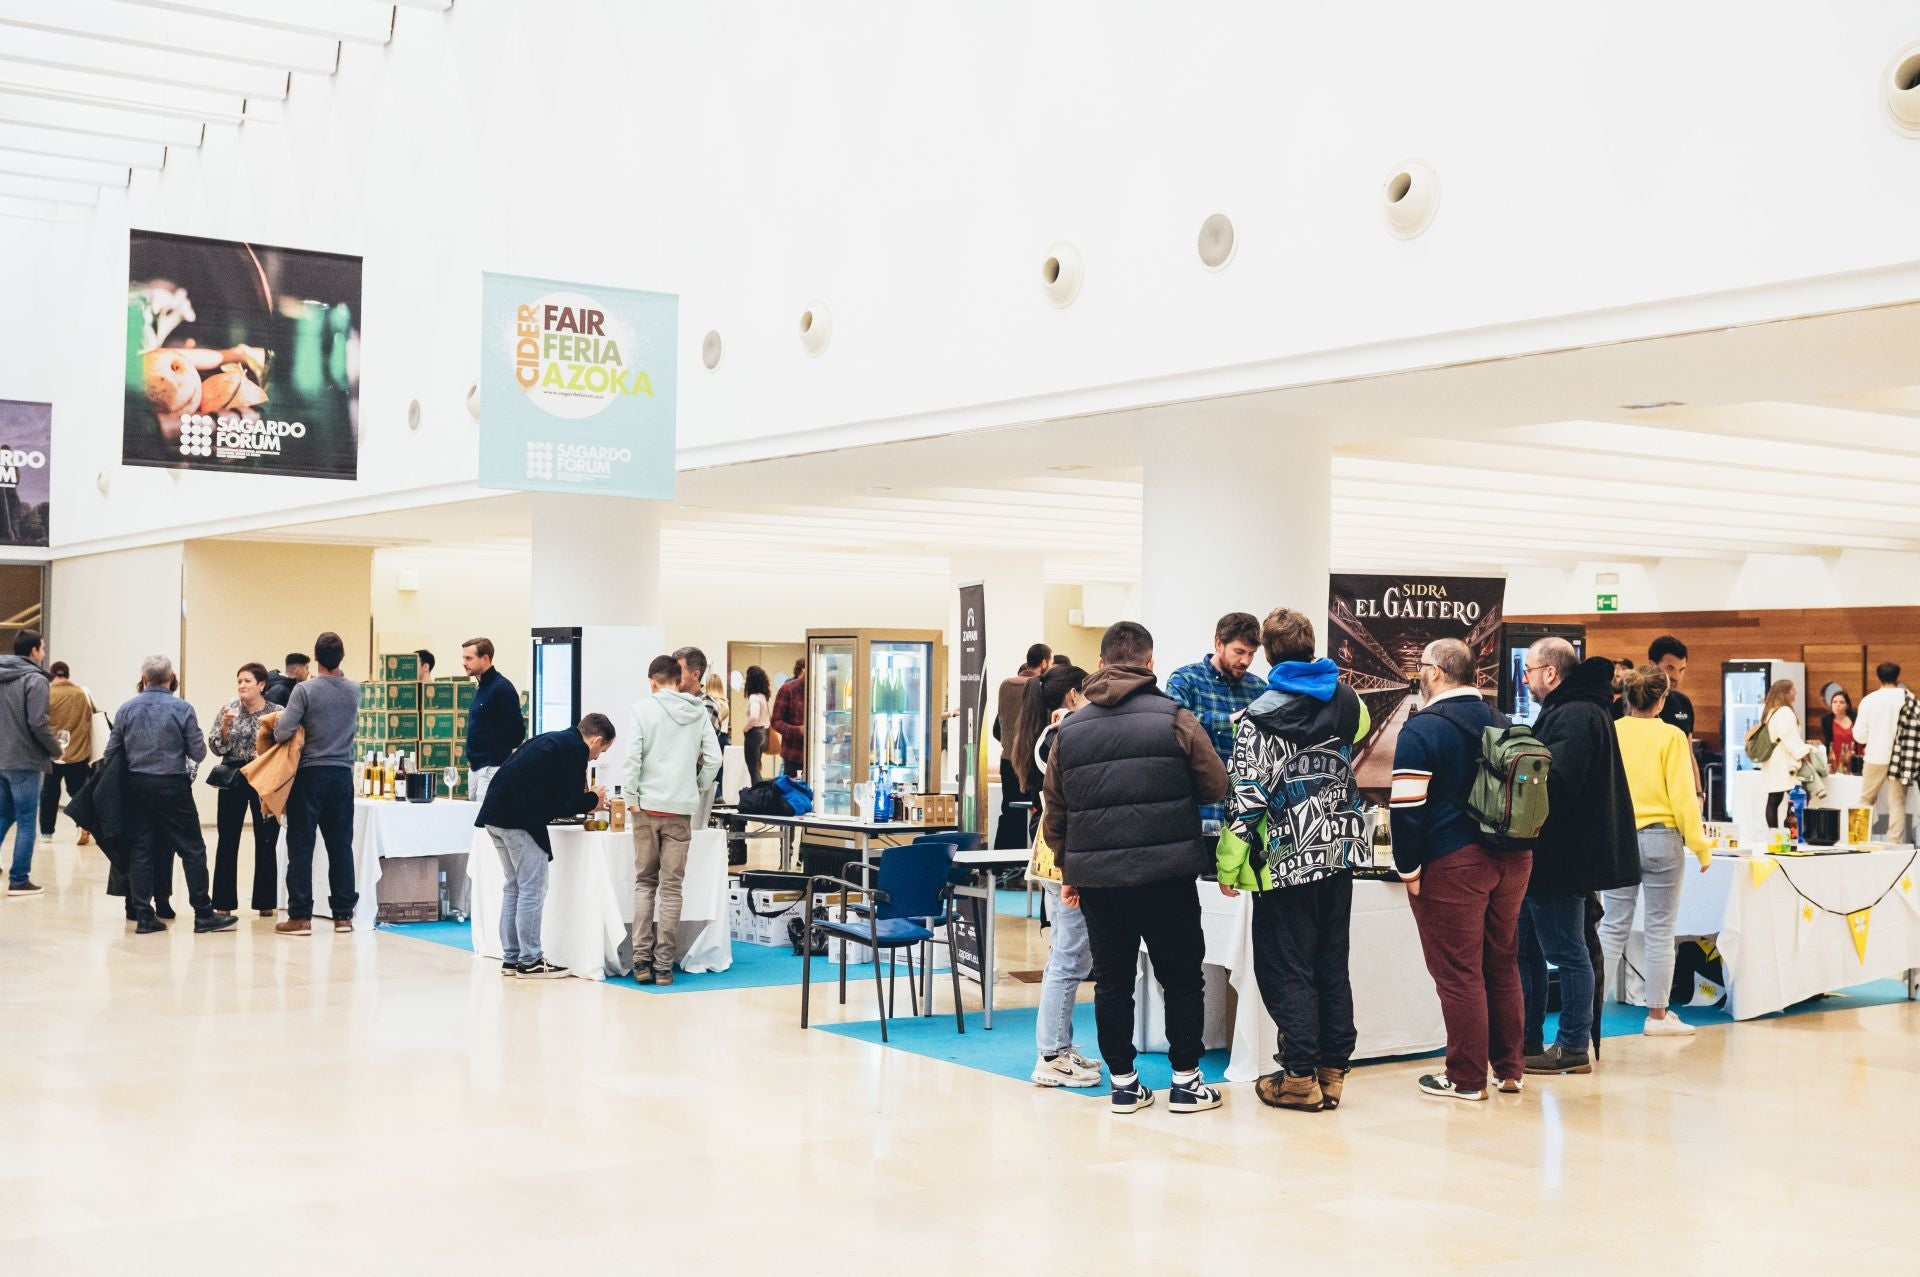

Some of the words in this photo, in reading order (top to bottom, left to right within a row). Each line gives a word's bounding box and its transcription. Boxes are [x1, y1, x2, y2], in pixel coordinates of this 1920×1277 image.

[544, 304, 605, 337] FAIR
[516, 303, 540, 390] CIDER
[543, 333, 623, 367] FERIA
[541, 362, 655, 398] AZOKA
[217, 416, 306, 438] SAGARDO
[217, 431, 281, 451] FORUM
[557, 443, 632, 463] SAGARDO
[557, 458, 611, 475] FORUM
[1402, 583, 1447, 599] SIDRA
[1355, 599, 1380, 618] EL
[1383, 586, 1481, 626] GAITERO
